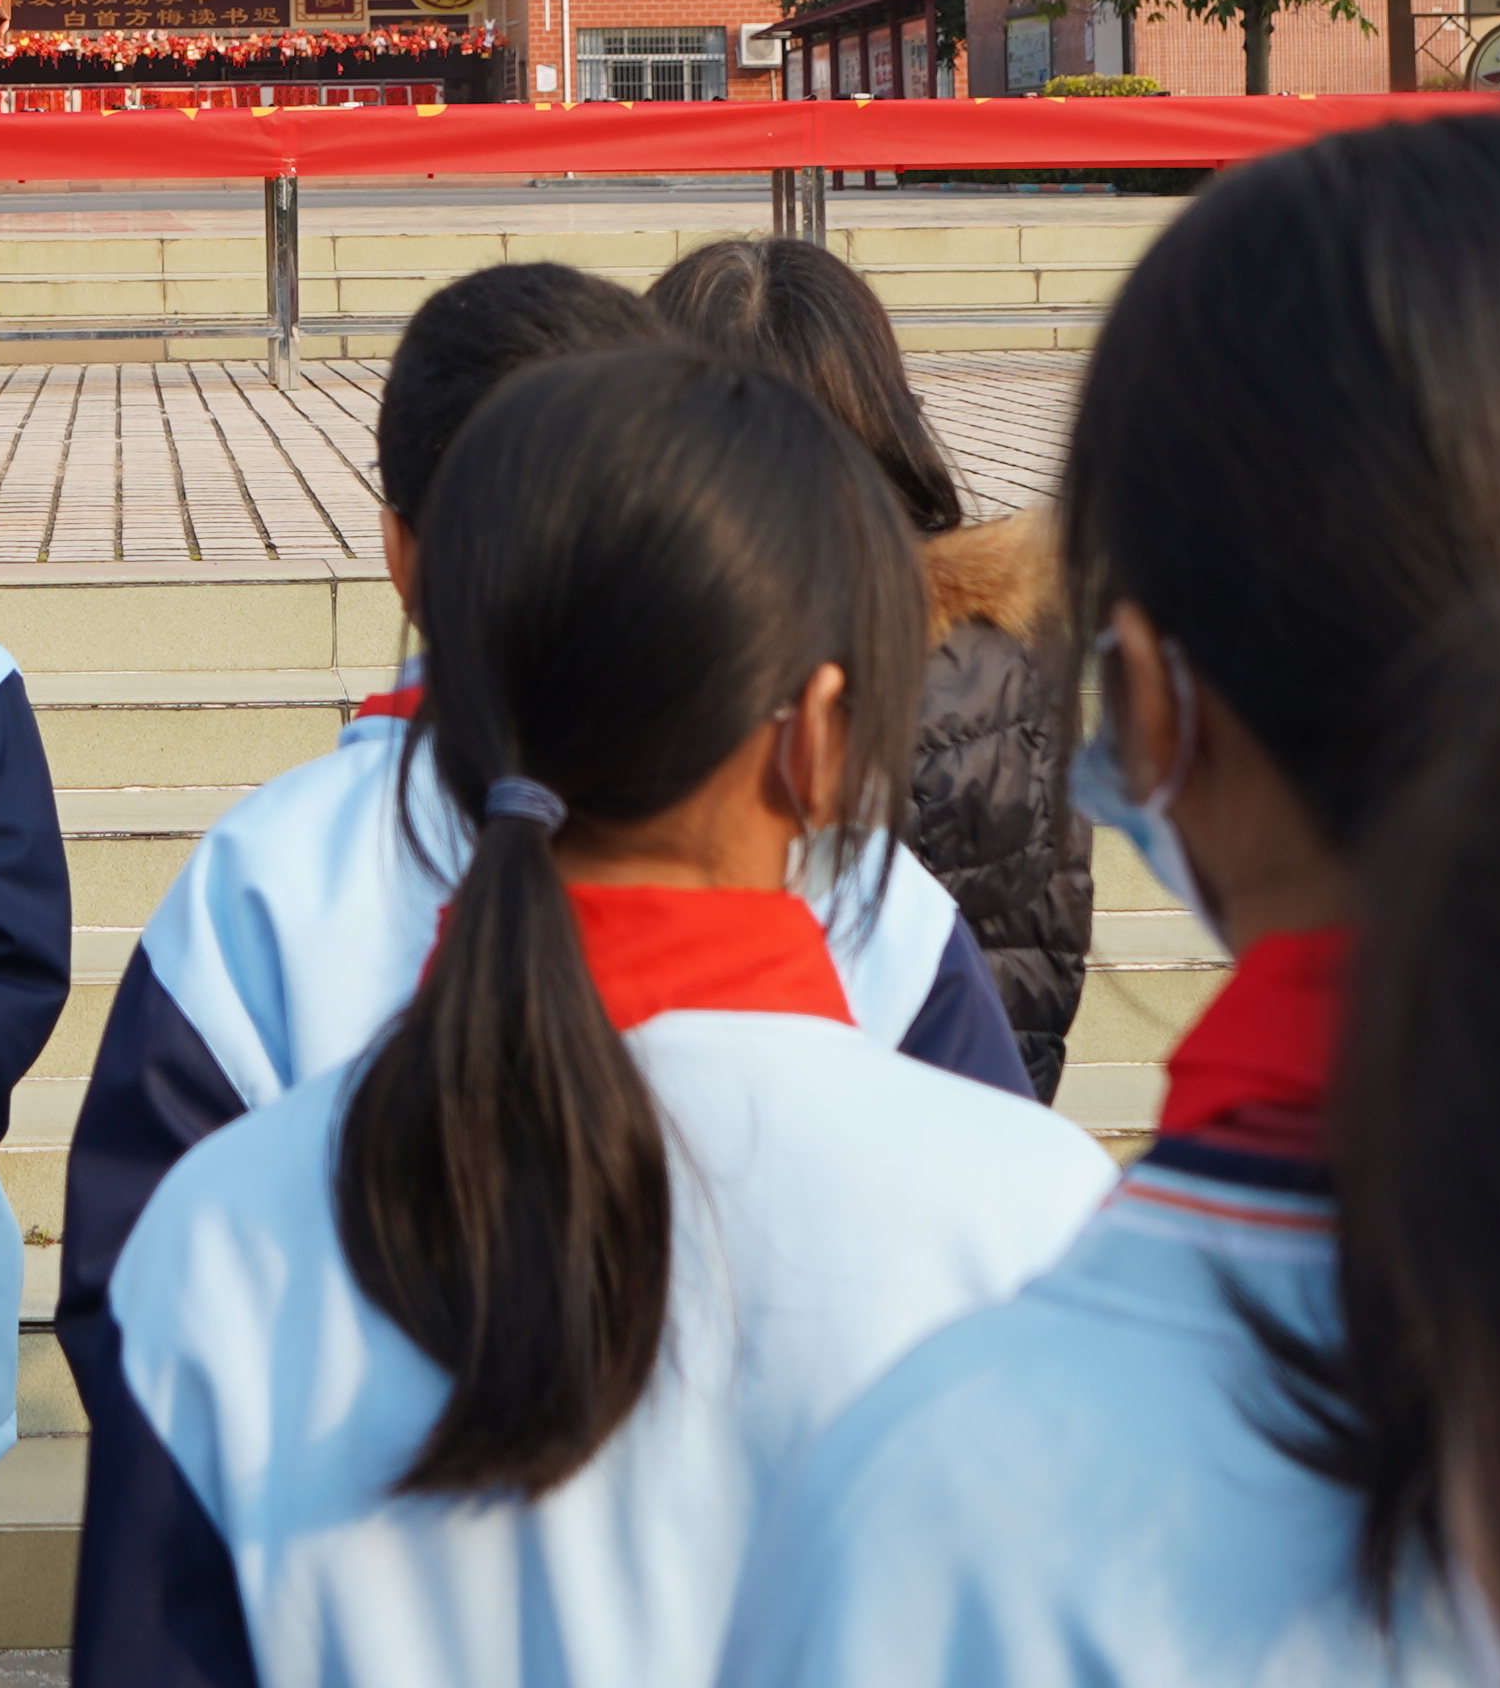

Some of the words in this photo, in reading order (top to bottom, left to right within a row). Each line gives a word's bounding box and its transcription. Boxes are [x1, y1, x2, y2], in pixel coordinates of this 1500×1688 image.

[63, 7, 281, 28] 白首方悔读书迟
